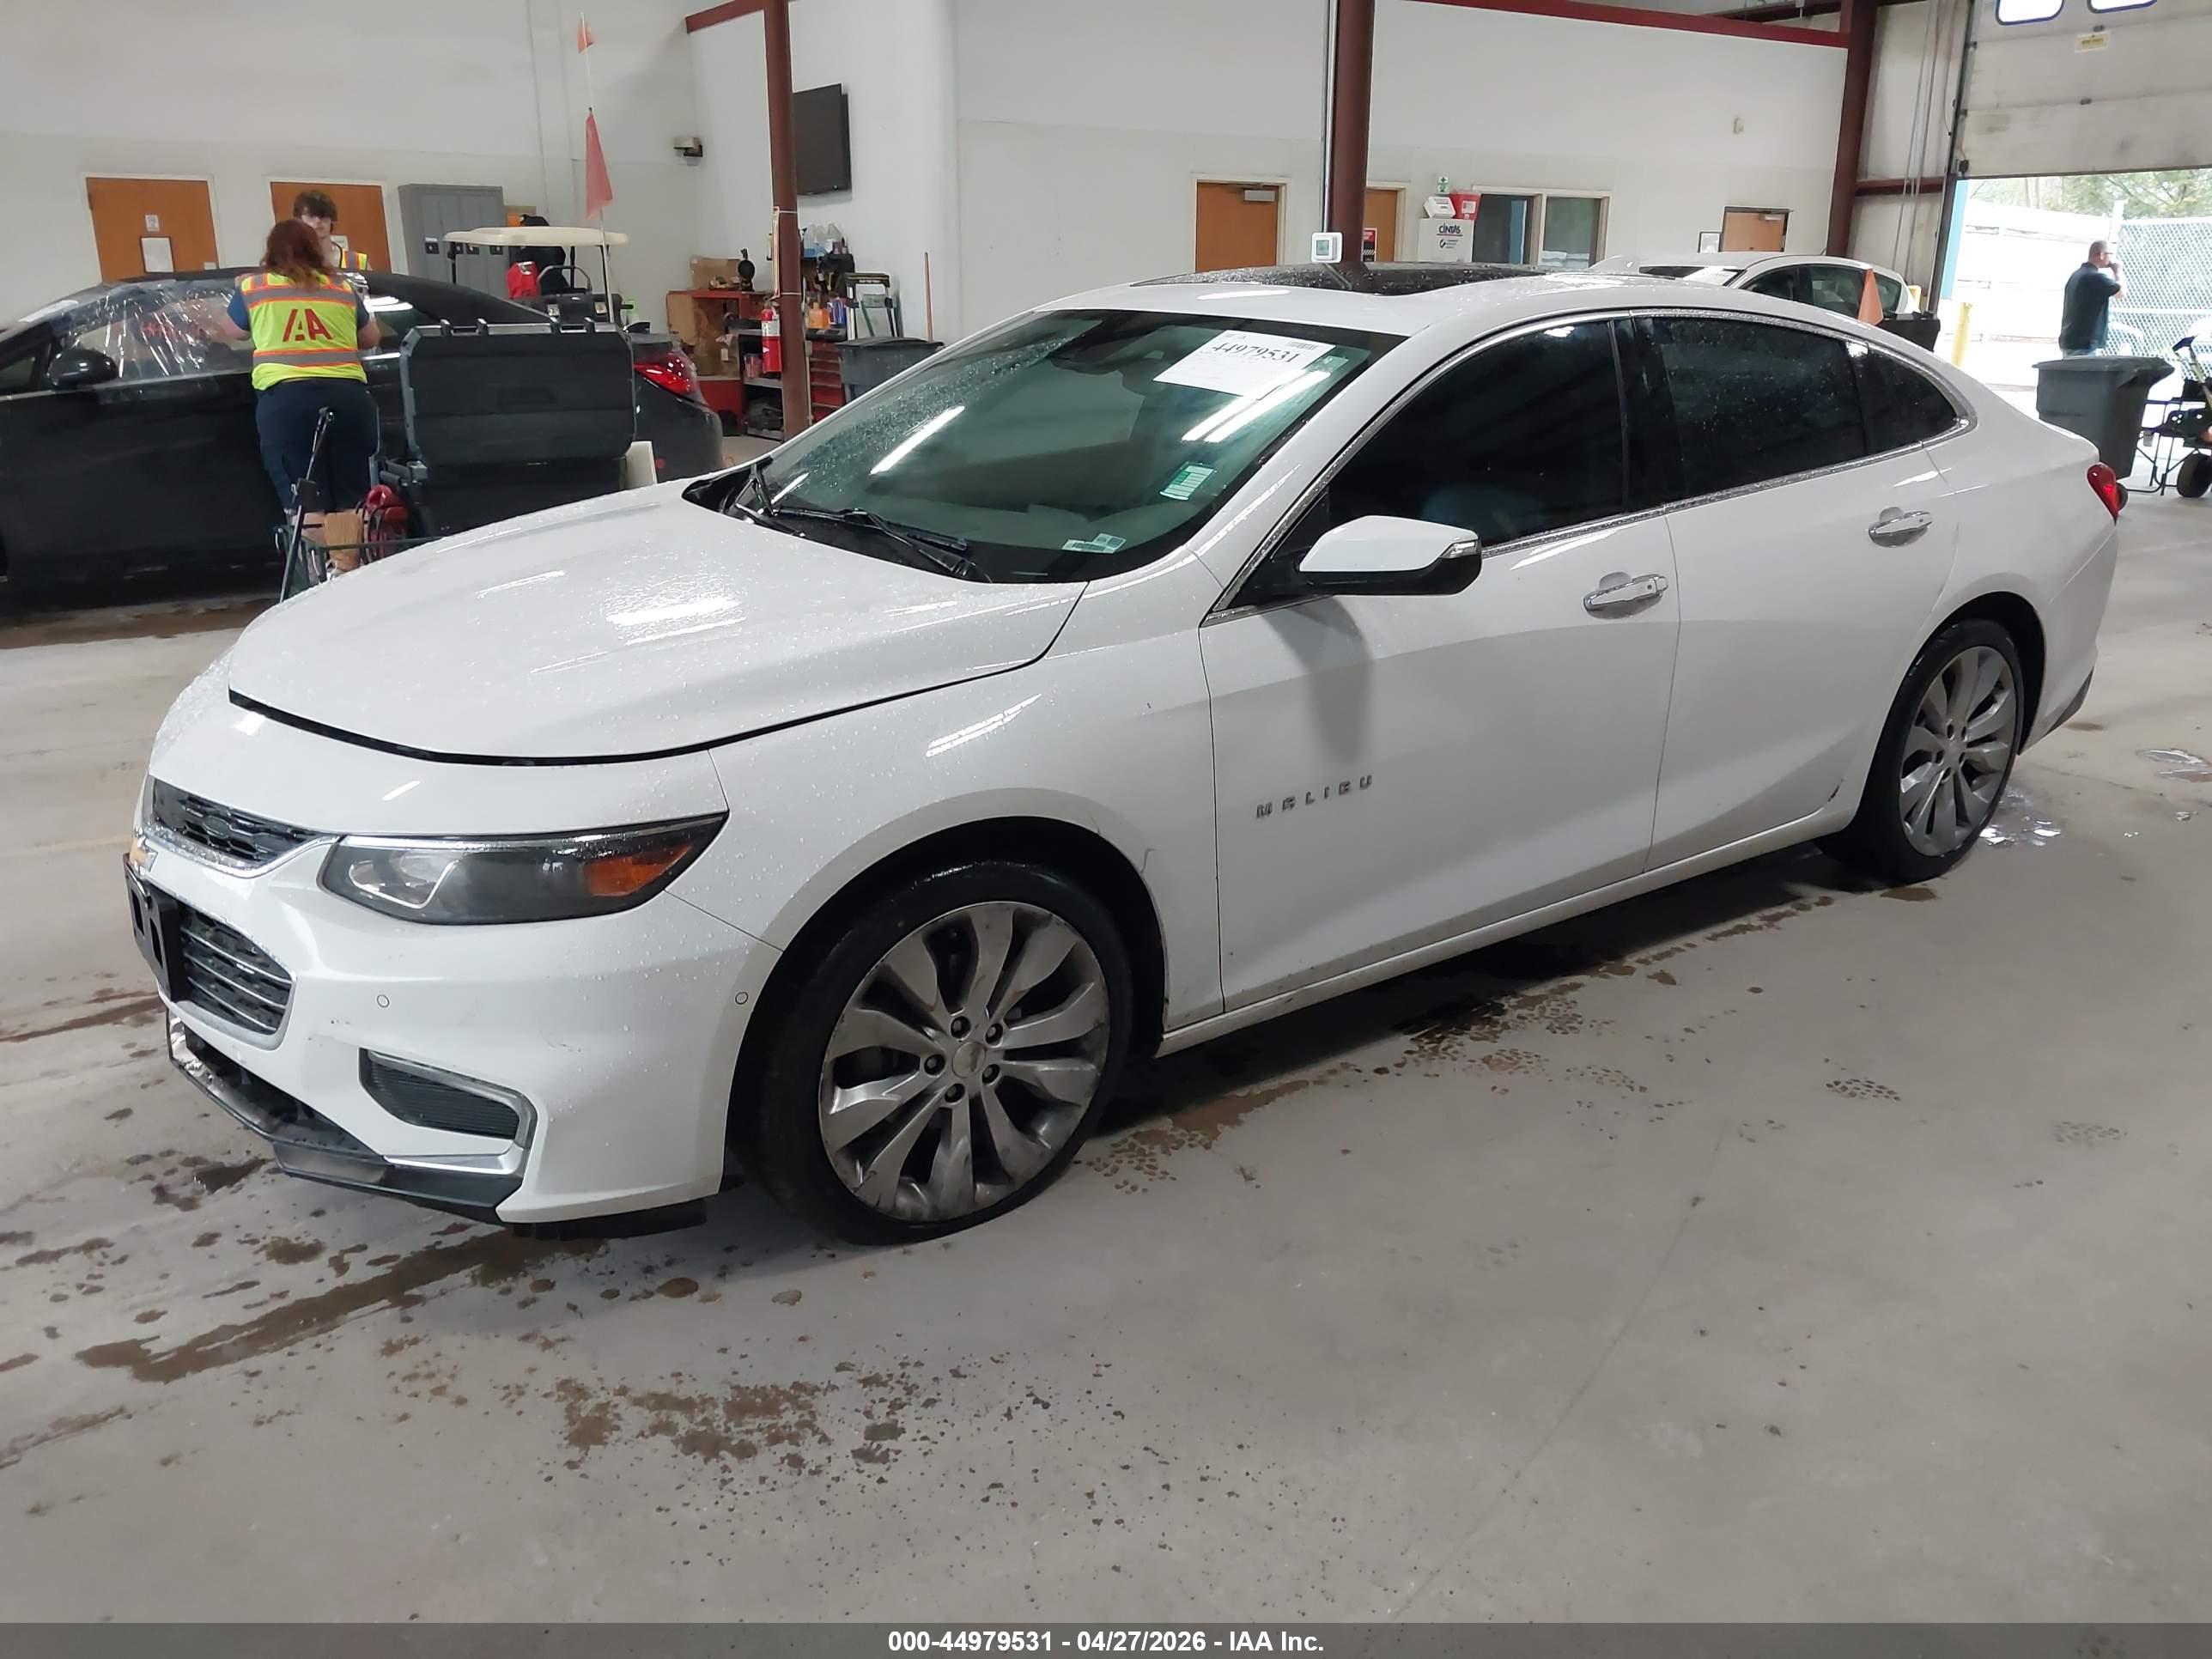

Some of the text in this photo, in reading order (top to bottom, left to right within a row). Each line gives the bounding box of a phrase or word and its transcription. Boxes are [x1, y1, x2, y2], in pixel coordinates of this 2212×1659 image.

[1438, 222, 1462, 234] CINTAS
[1212, 342, 1301, 363] 44979531
[1256, 775, 1372, 818] MALIBU
